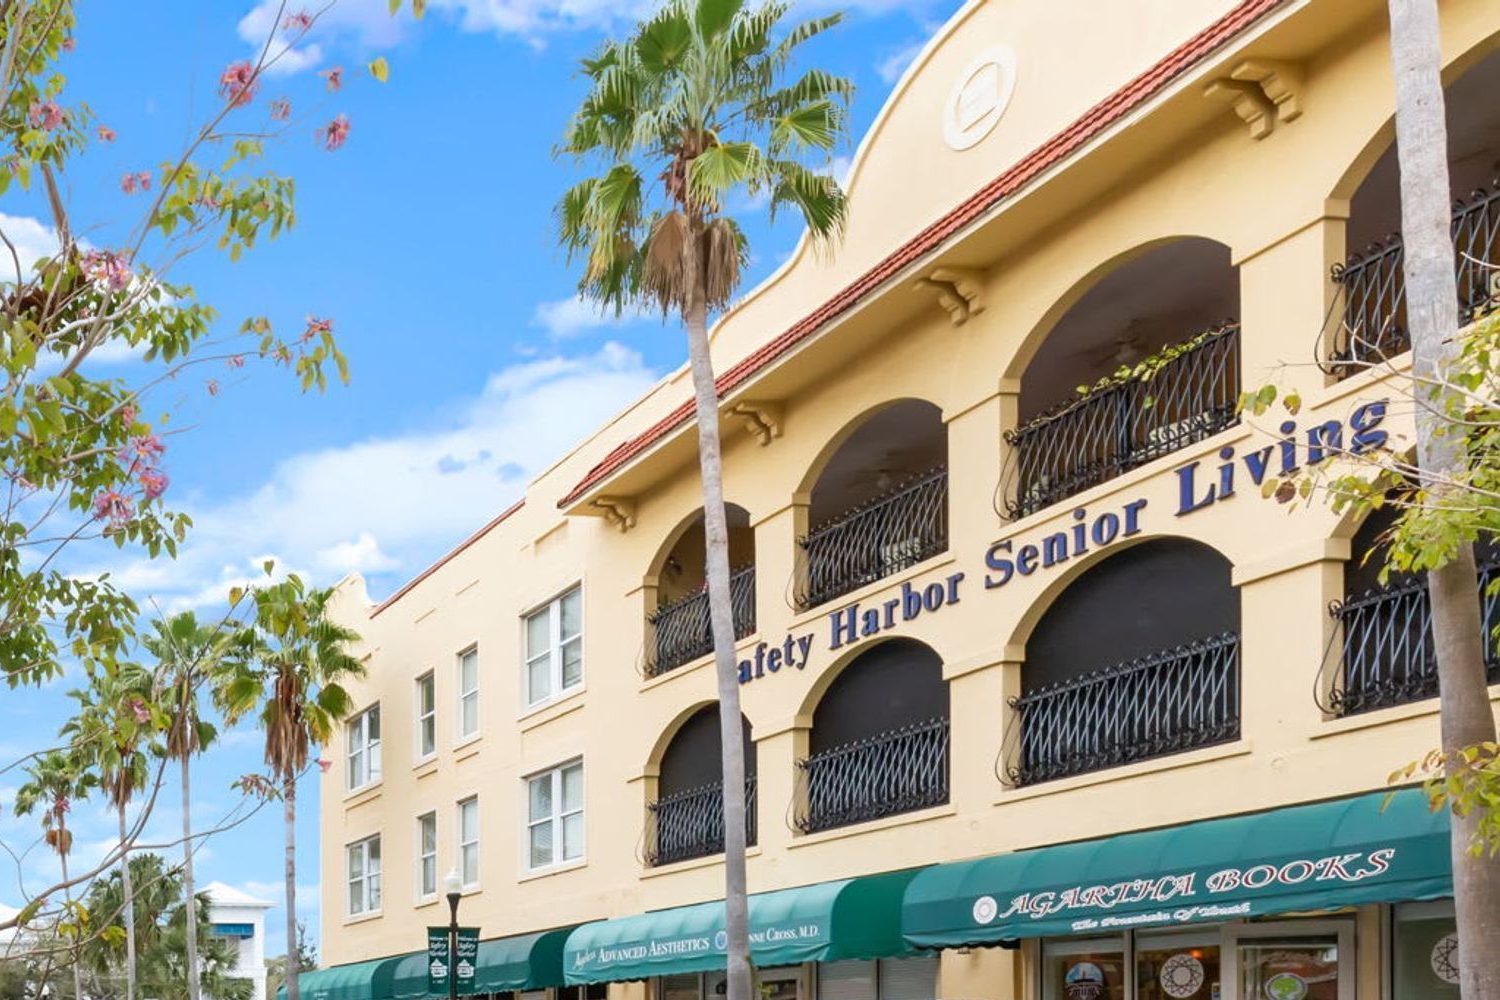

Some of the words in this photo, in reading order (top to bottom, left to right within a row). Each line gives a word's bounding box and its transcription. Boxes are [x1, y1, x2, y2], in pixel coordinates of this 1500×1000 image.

[737, 632, 815, 685] afety
[828, 571, 965, 651] Harbor
[983, 498, 1149, 591] Senior
[1174, 397, 1391, 518] Living
[999, 871, 1196, 918] AGARTHA
[1205, 848, 1396, 894] BOOKS
